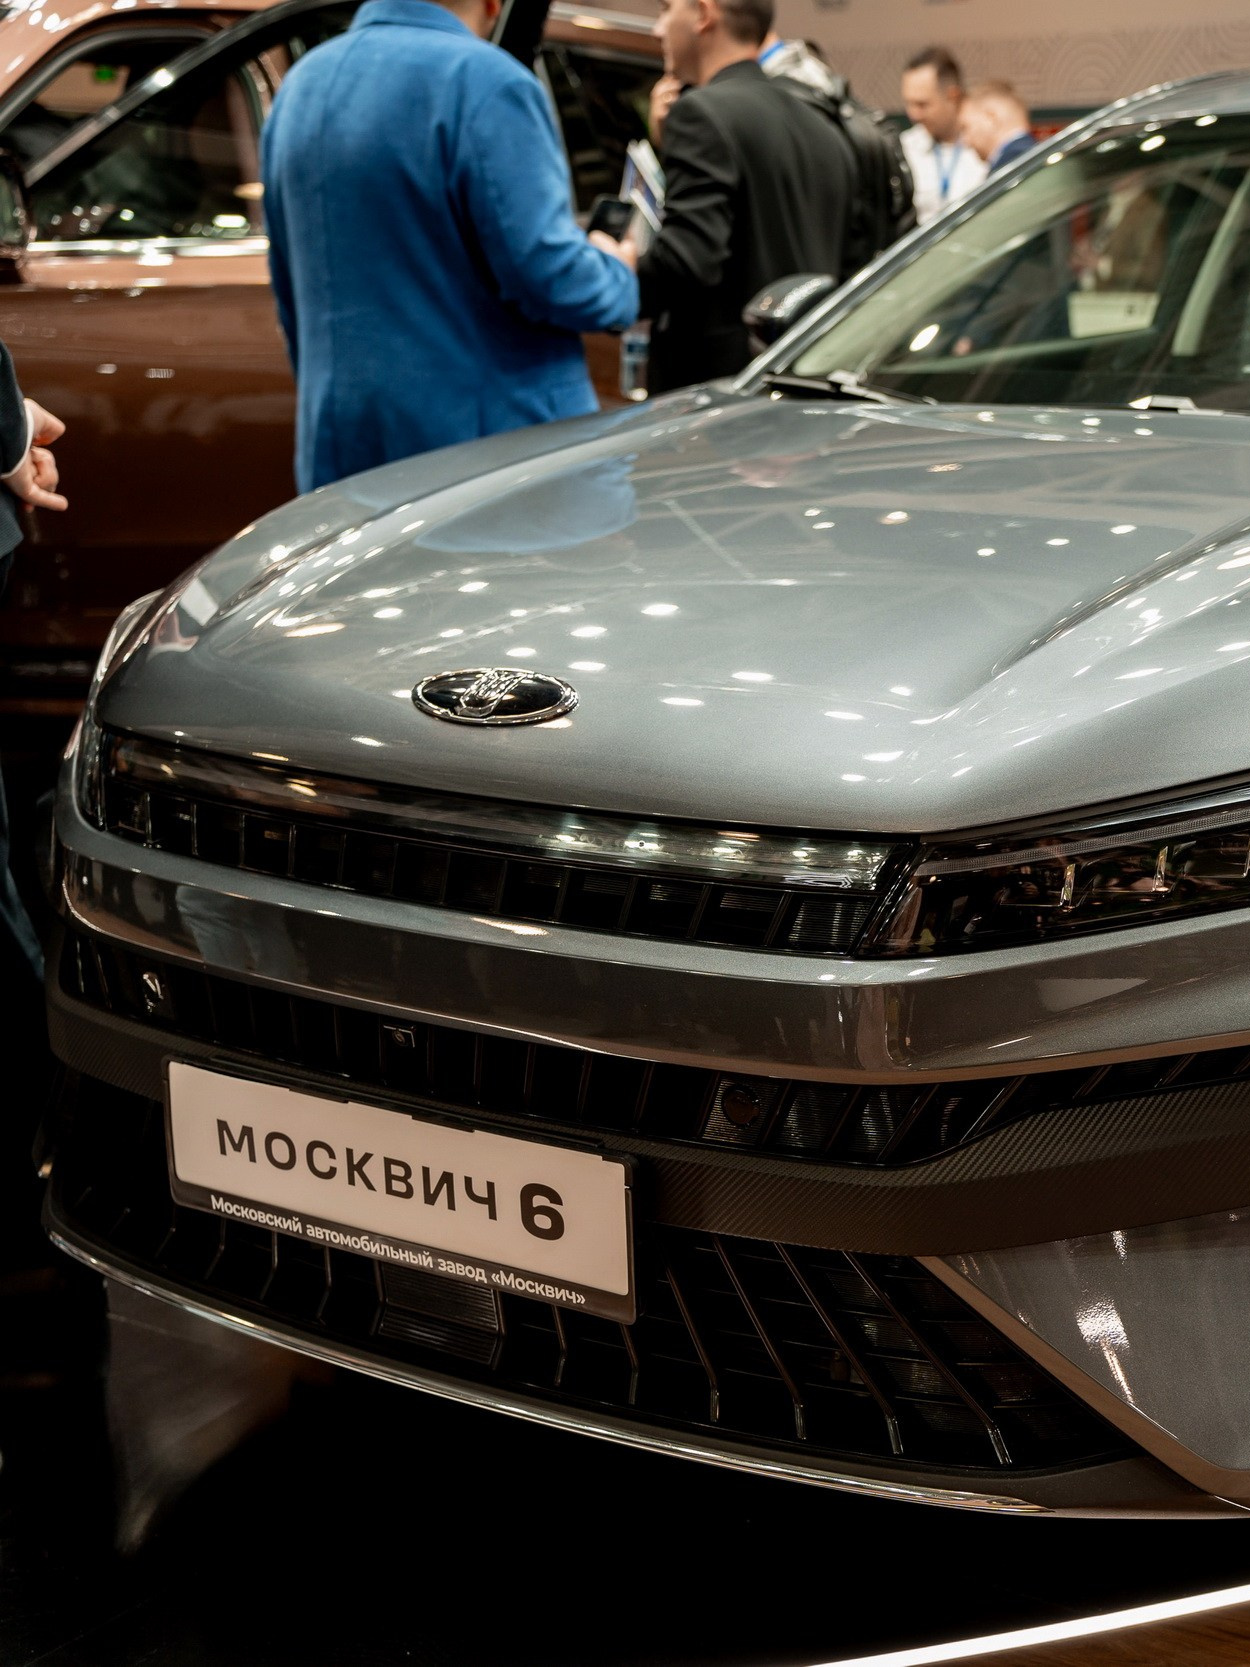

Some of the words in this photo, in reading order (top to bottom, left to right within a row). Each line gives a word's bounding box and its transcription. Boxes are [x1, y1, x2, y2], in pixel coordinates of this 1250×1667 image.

[216, 1118, 498, 1222] МОСКВИЧ
[519, 1182, 566, 1241] 6
[210, 1194, 303, 1235] Московский
[306, 1224, 434, 1270] автомобильный
[437, 1257, 488, 1284] завод
[490, 1269, 587, 1306] «Москвич»
